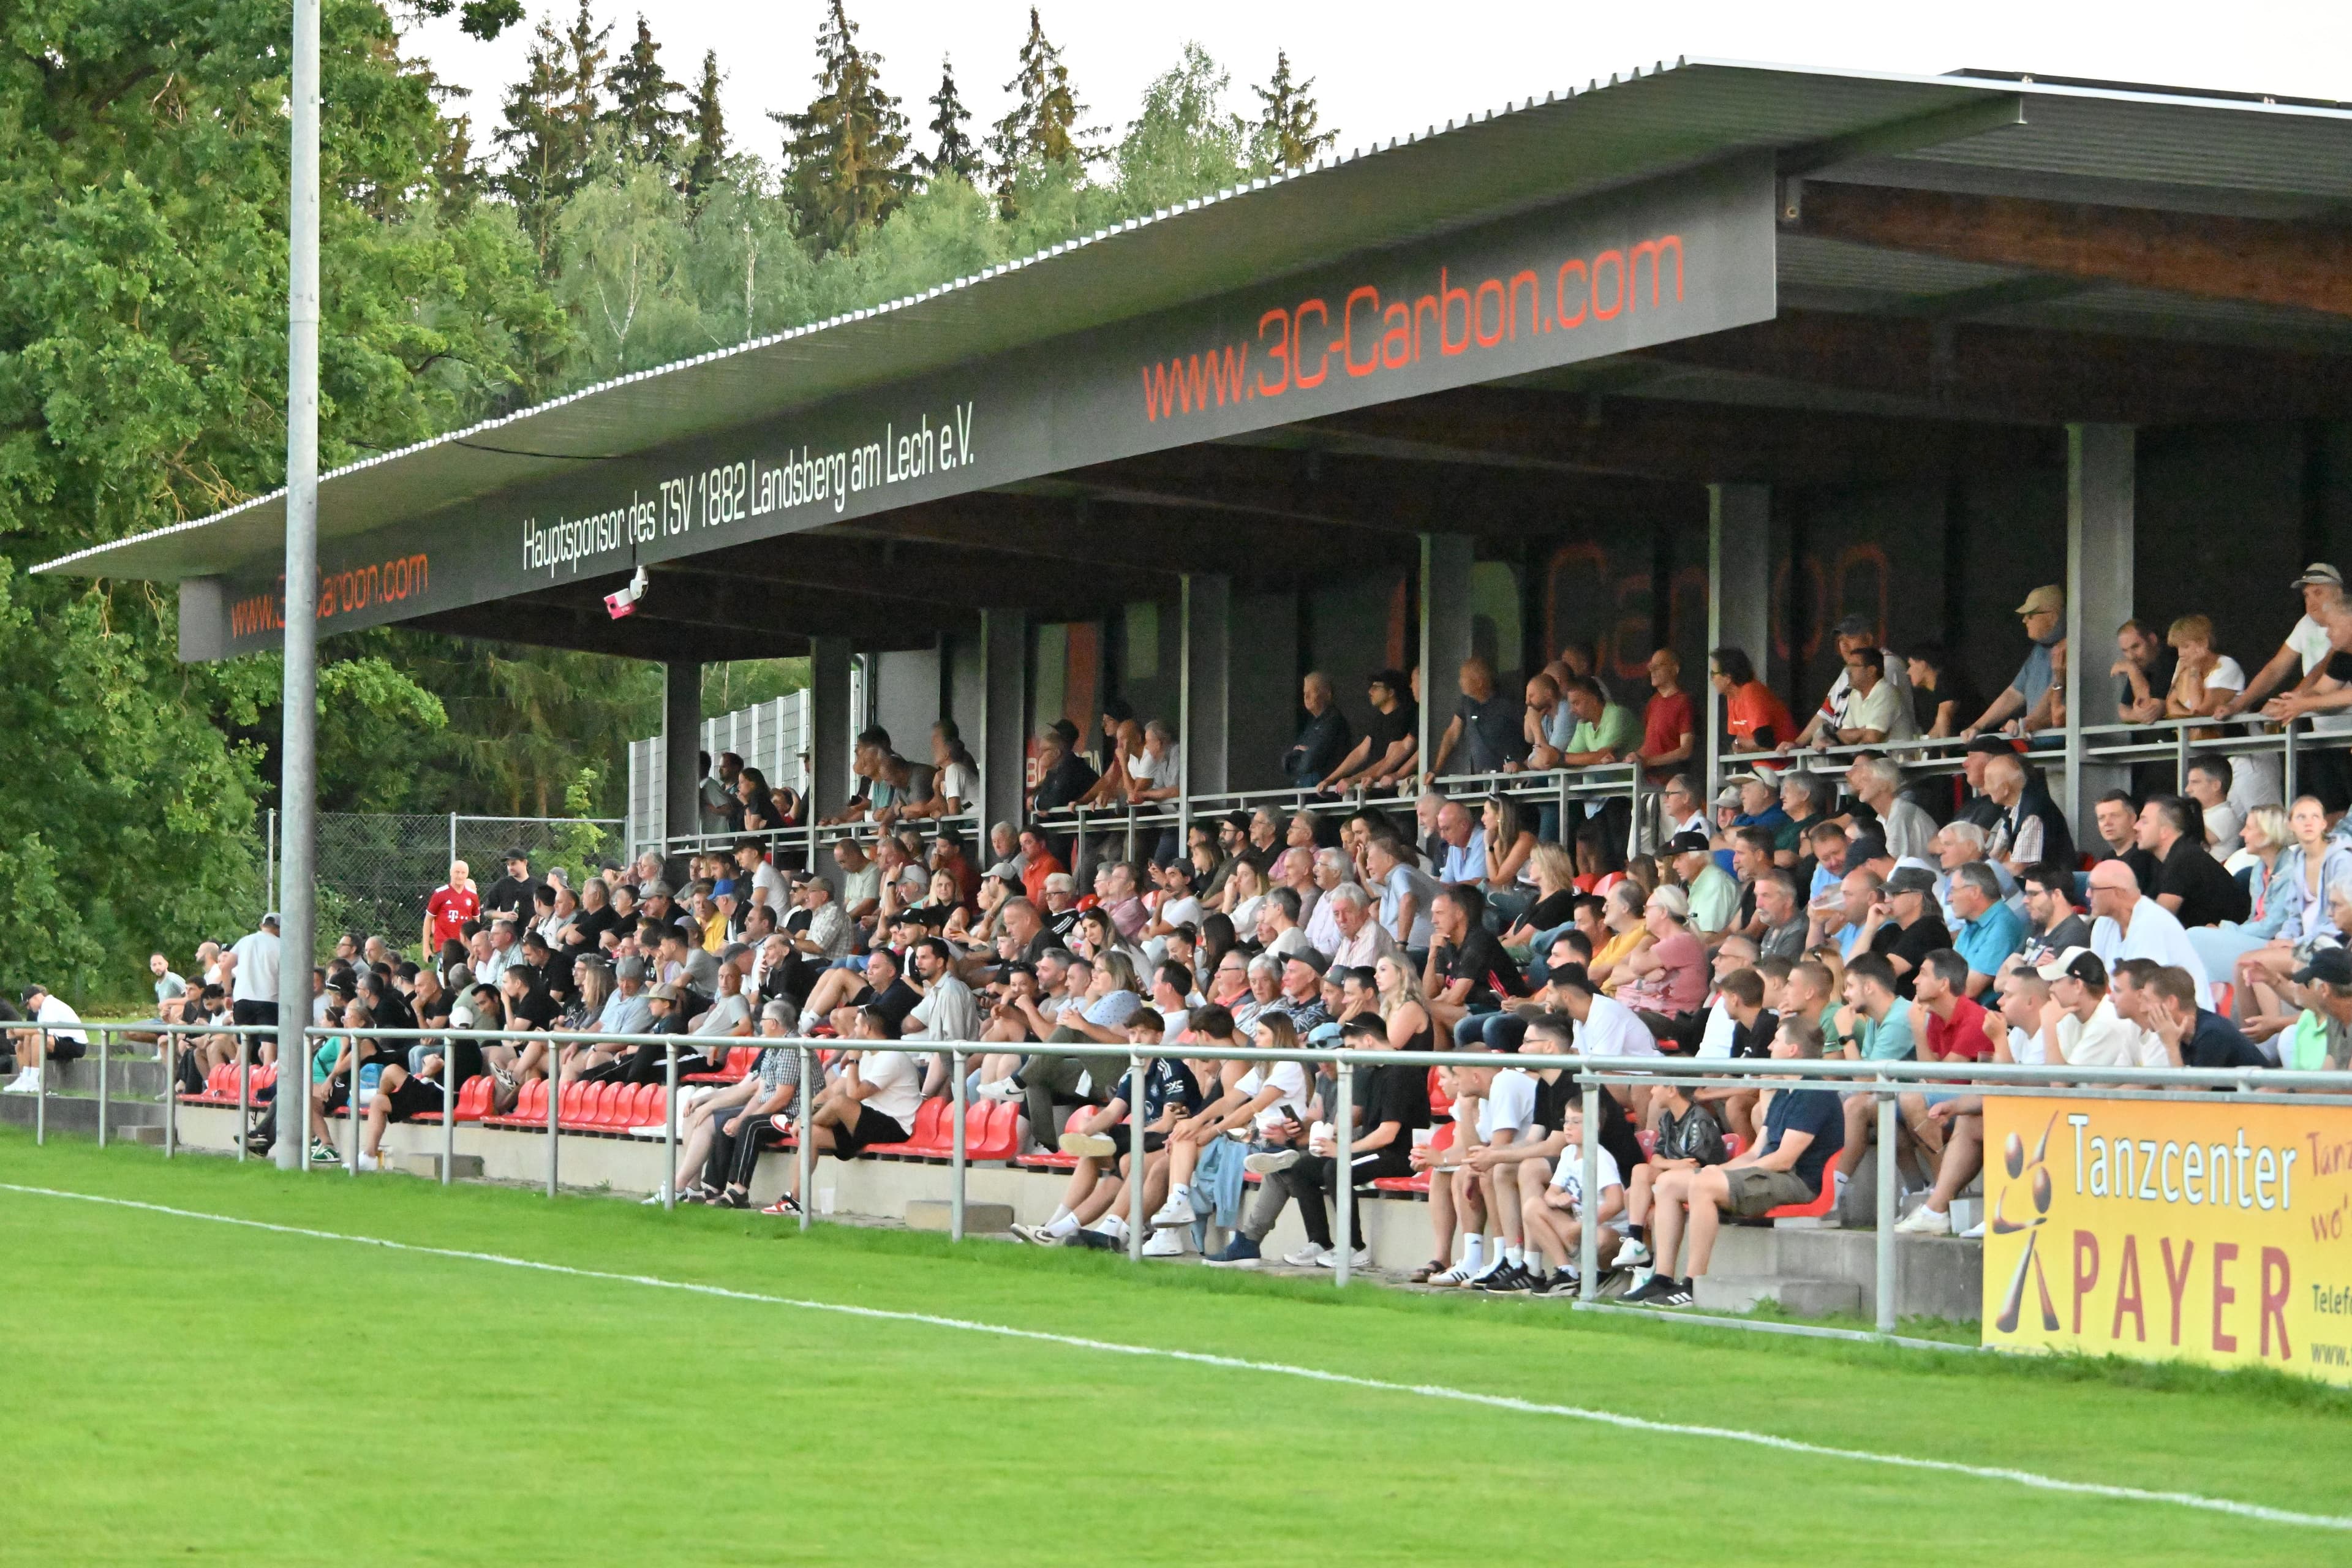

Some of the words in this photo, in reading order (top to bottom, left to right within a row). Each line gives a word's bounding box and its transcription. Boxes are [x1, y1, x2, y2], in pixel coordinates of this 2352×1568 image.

[1142, 234, 1686, 423] www.3C-Carbon.com
[523, 516, 625, 579] Hauptsponsor
[628, 489, 656, 545] des
[660, 475, 693, 537] TSV
[699, 461, 745, 528] 1882
[752, 445, 845, 513] Landsberg
[851, 443, 880, 492] am
[887, 413, 933, 483] Lech
[940, 401, 974, 470] e.V.
[231, 553, 429, 638] www.3arbon.com
[2067, 1113, 2297, 1210] Tanzcenter
[2071, 1229, 2292, 1361] PAYER
[2312, 1284, 2352, 1316] Telef
[2310, 1342, 2352, 1368] www.
